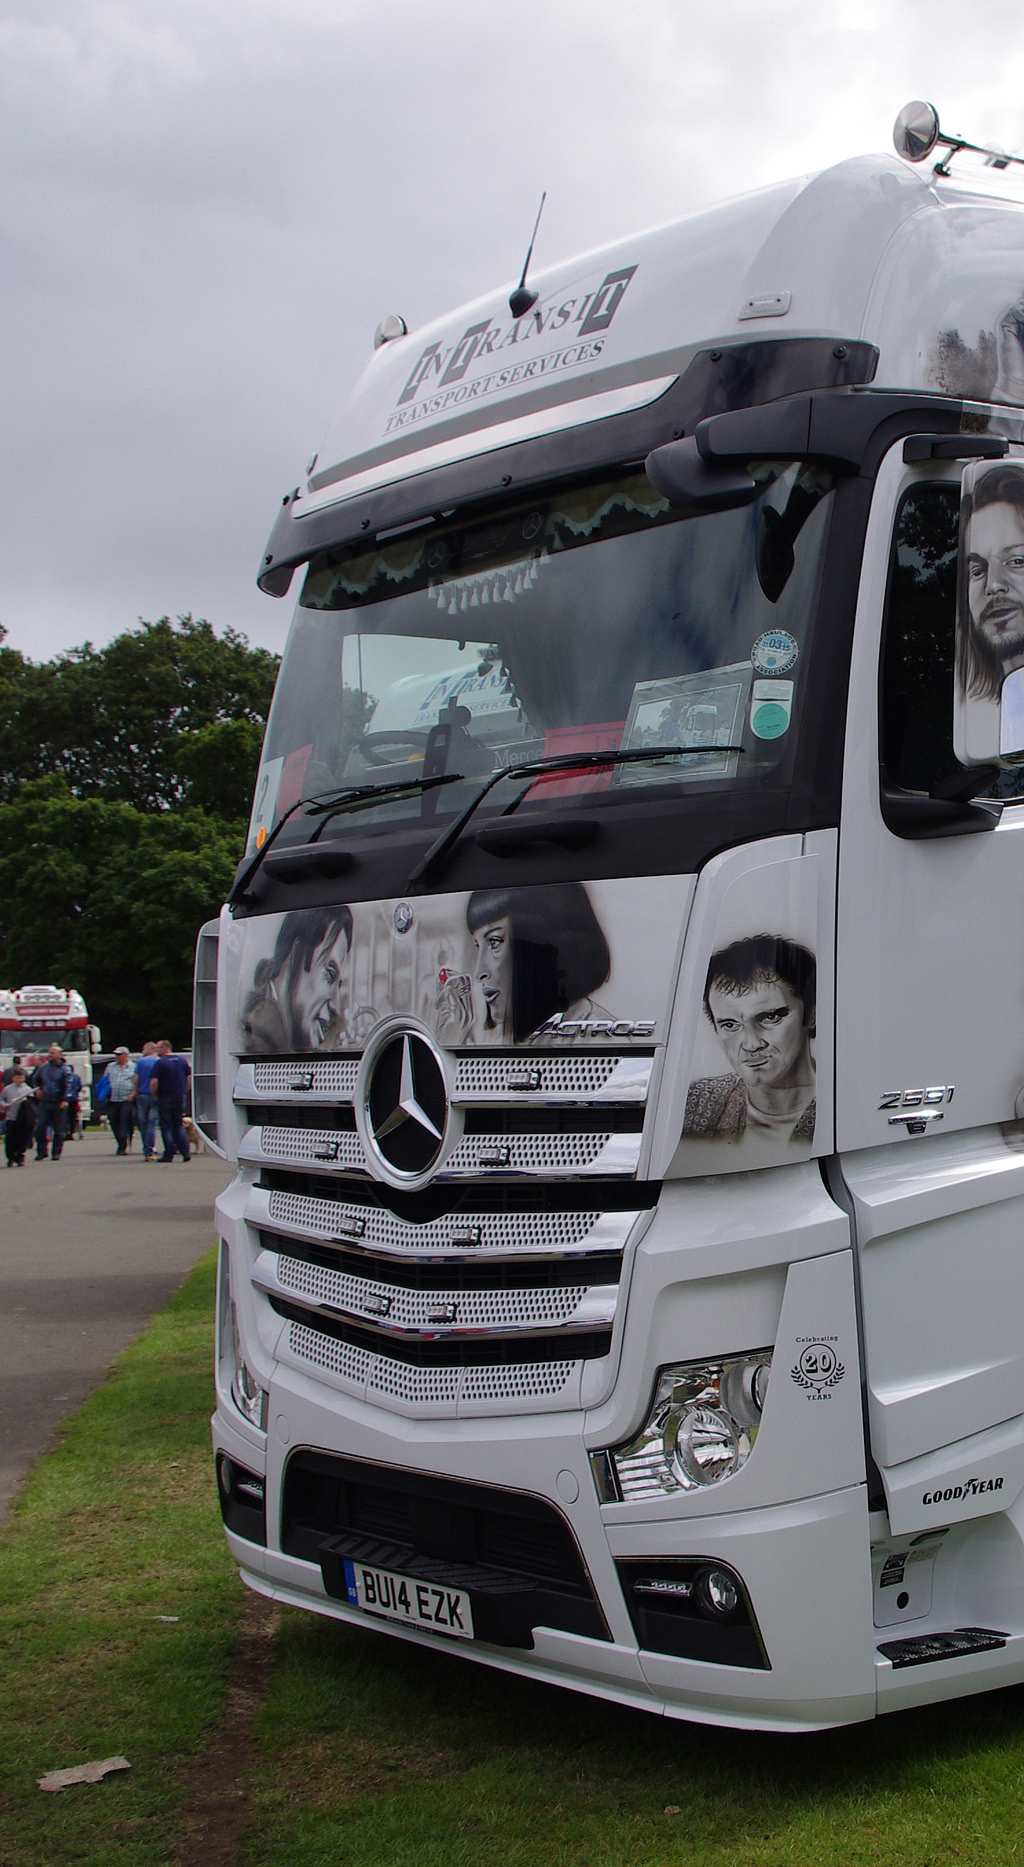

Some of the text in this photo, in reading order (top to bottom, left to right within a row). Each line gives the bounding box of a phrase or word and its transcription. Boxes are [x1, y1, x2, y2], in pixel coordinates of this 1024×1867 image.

[438, 264, 639, 388] TRANSIT
[384, 339, 606, 432] TRANSPORT SERVICES
[878, 1085, 955, 1110] 2551
[795, 1335, 839, 1343] Celebrating
[805, 1352, 832, 1374] 20
[806, 1393, 832, 1401] YEARS
[922, 1477, 1004, 1505] GOODYEAR
[362, 1569, 411, 1614] BU14
[415, 1584, 464, 1630] EZK
